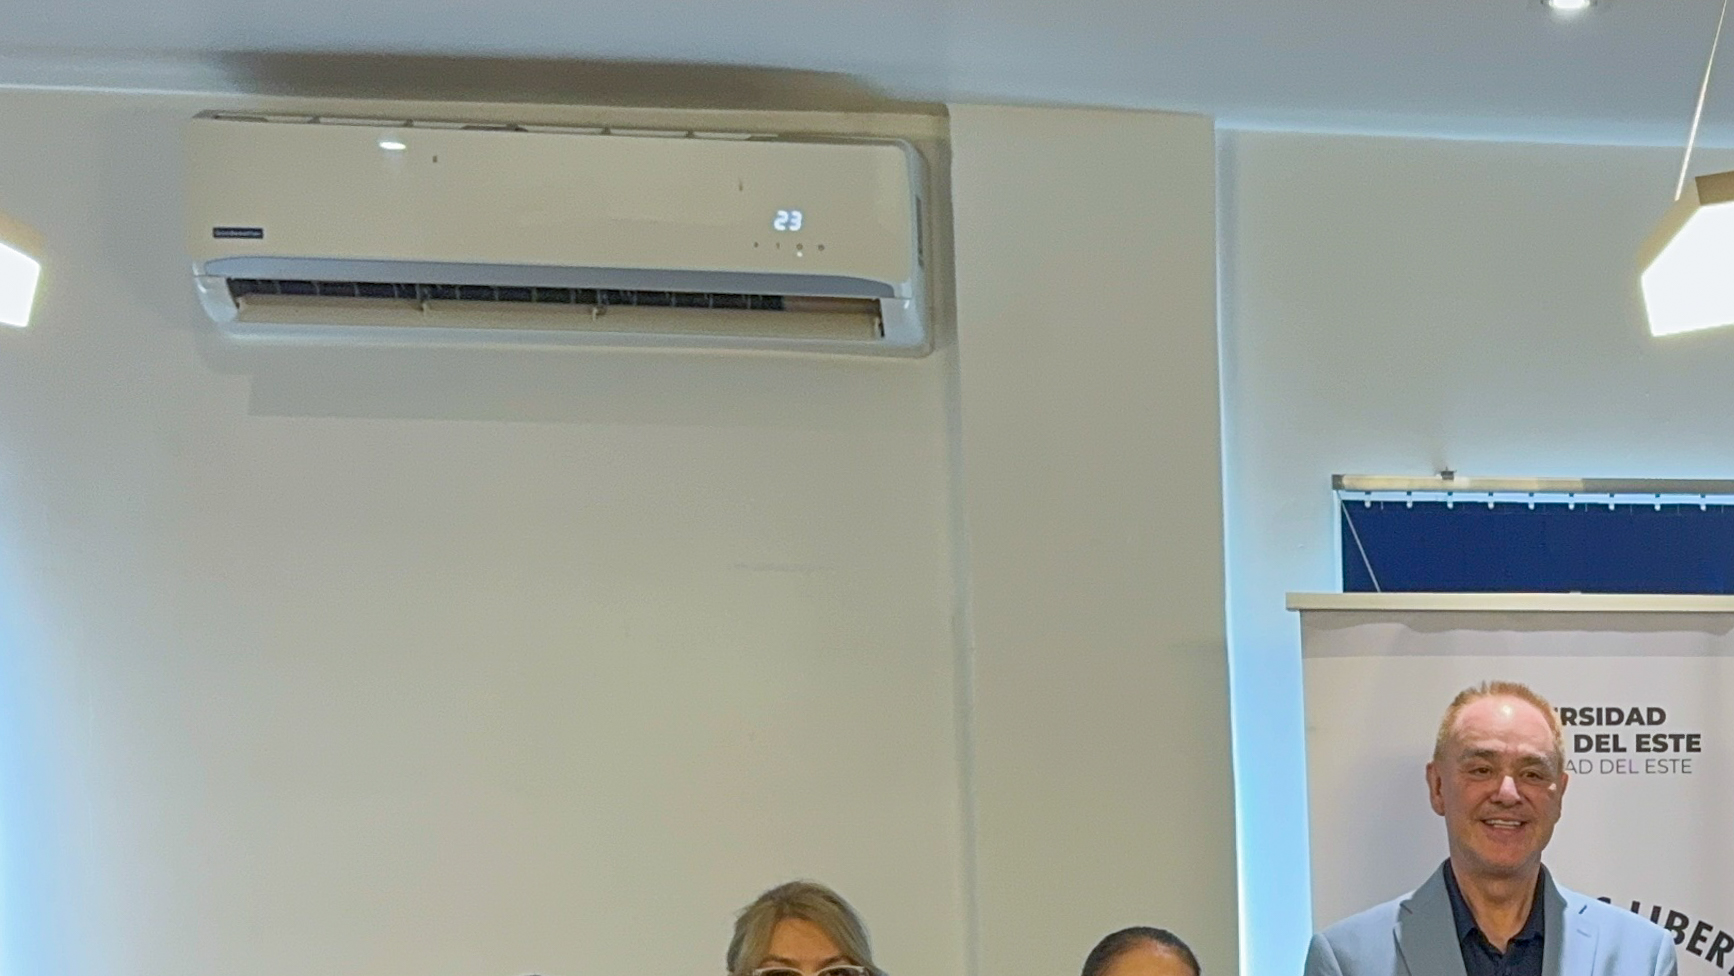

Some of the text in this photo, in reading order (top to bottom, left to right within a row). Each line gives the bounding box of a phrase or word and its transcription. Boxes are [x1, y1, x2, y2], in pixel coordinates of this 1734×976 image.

[774, 210, 803, 232] 23
[1554, 707, 1667, 726] RSIDAD
[1573, 733, 1702, 753] DEL ESTE
[1599, 758, 1639, 775] DEL
[1644, 758, 1692, 775] ESTE
